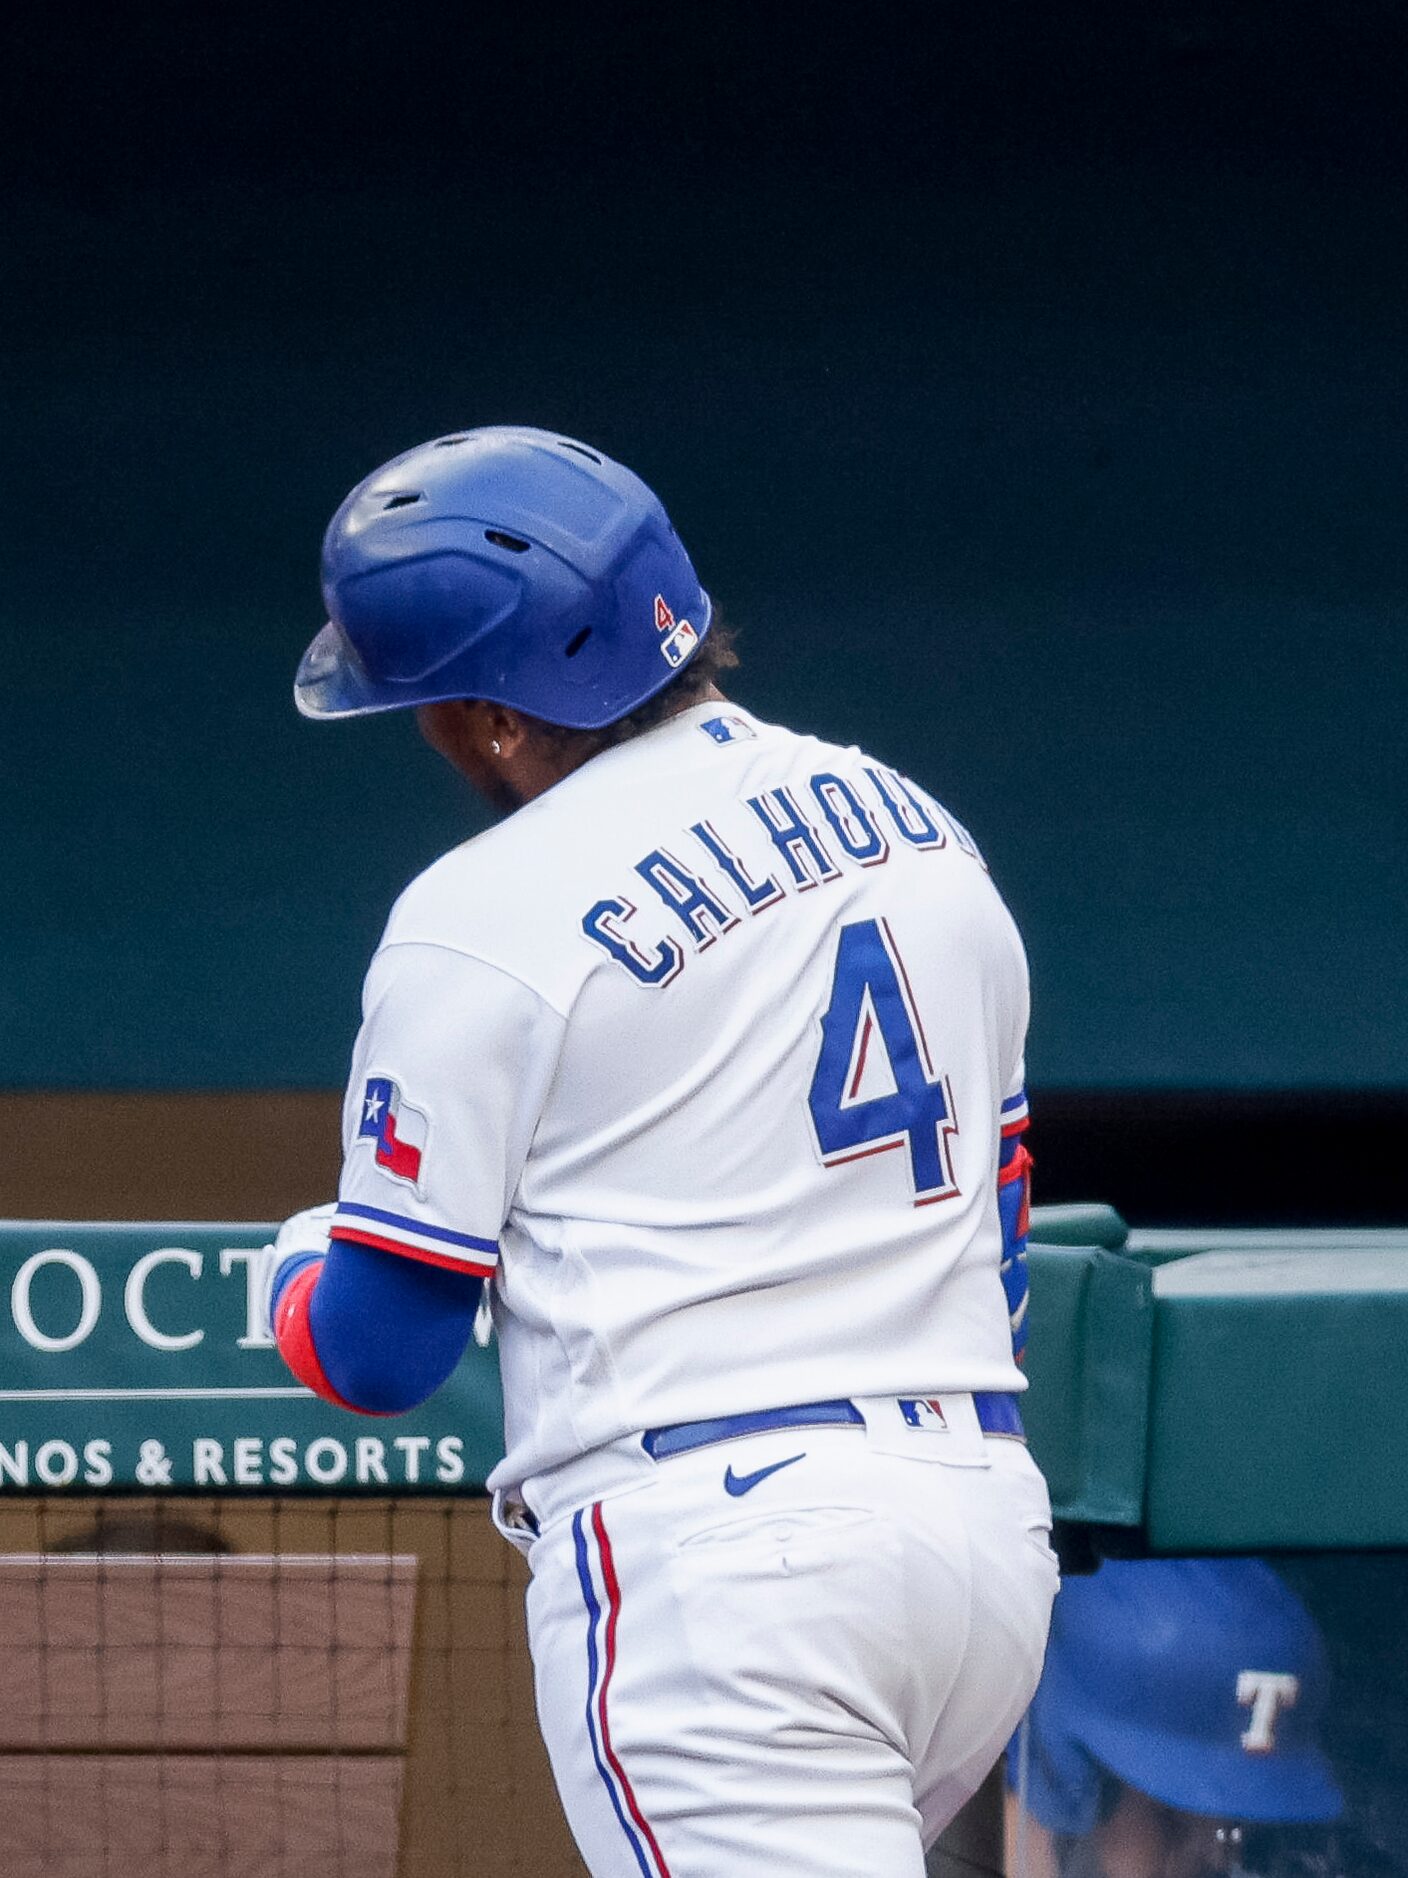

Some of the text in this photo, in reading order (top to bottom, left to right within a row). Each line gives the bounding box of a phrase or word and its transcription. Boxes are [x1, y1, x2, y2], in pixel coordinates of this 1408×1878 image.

[654, 593, 676, 632] 4
[807, 916, 962, 1207] 4
[0, 1436, 465, 1487] NOS & RESORTS
[1235, 1669, 1299, 1756] T
